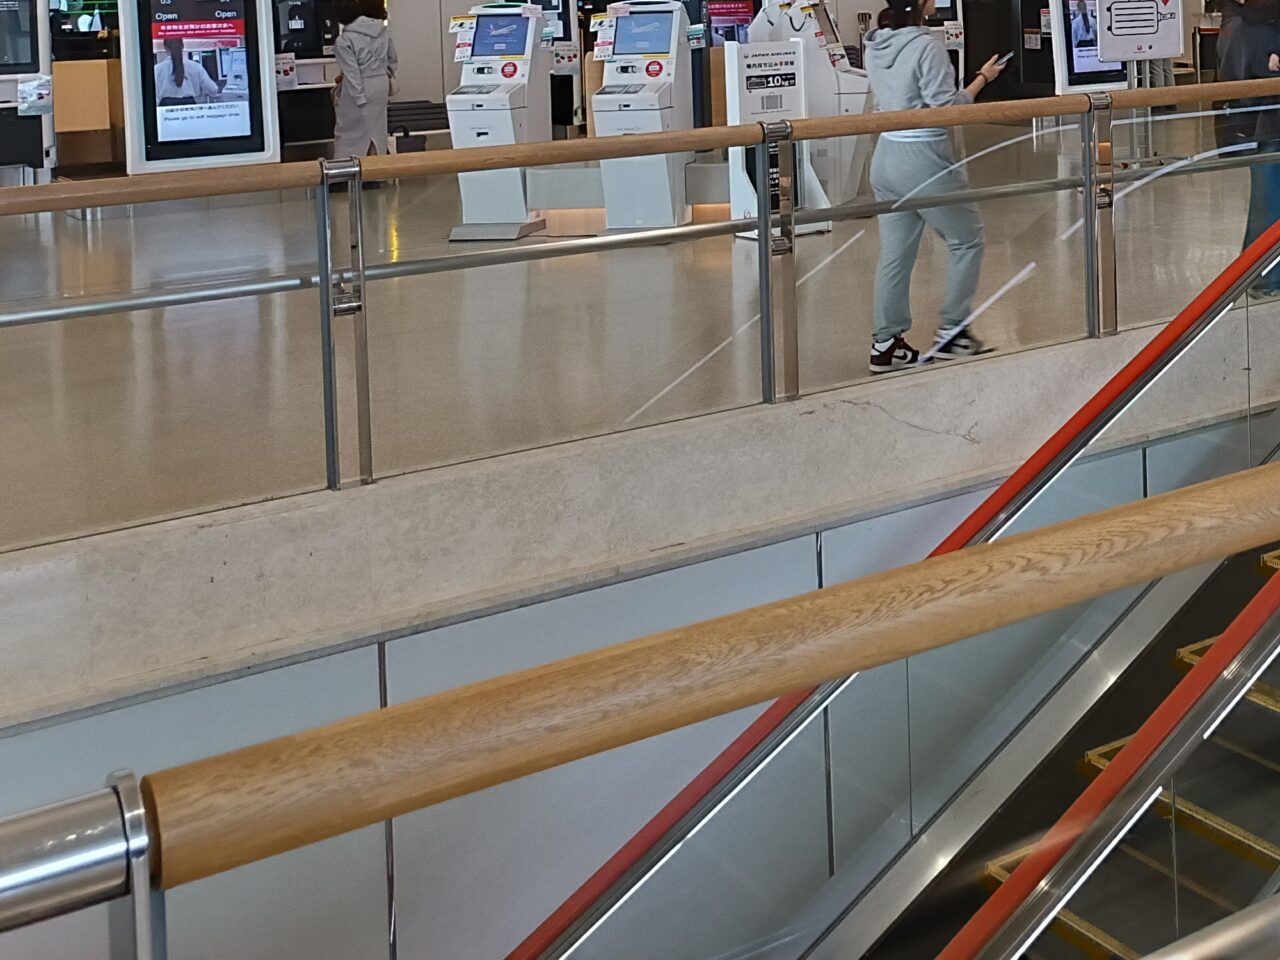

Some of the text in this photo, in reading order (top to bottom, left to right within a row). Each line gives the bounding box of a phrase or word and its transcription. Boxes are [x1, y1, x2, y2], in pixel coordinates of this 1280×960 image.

[155, 11, 236, 21] Open Open
[768, 76, 782, 86] 10
